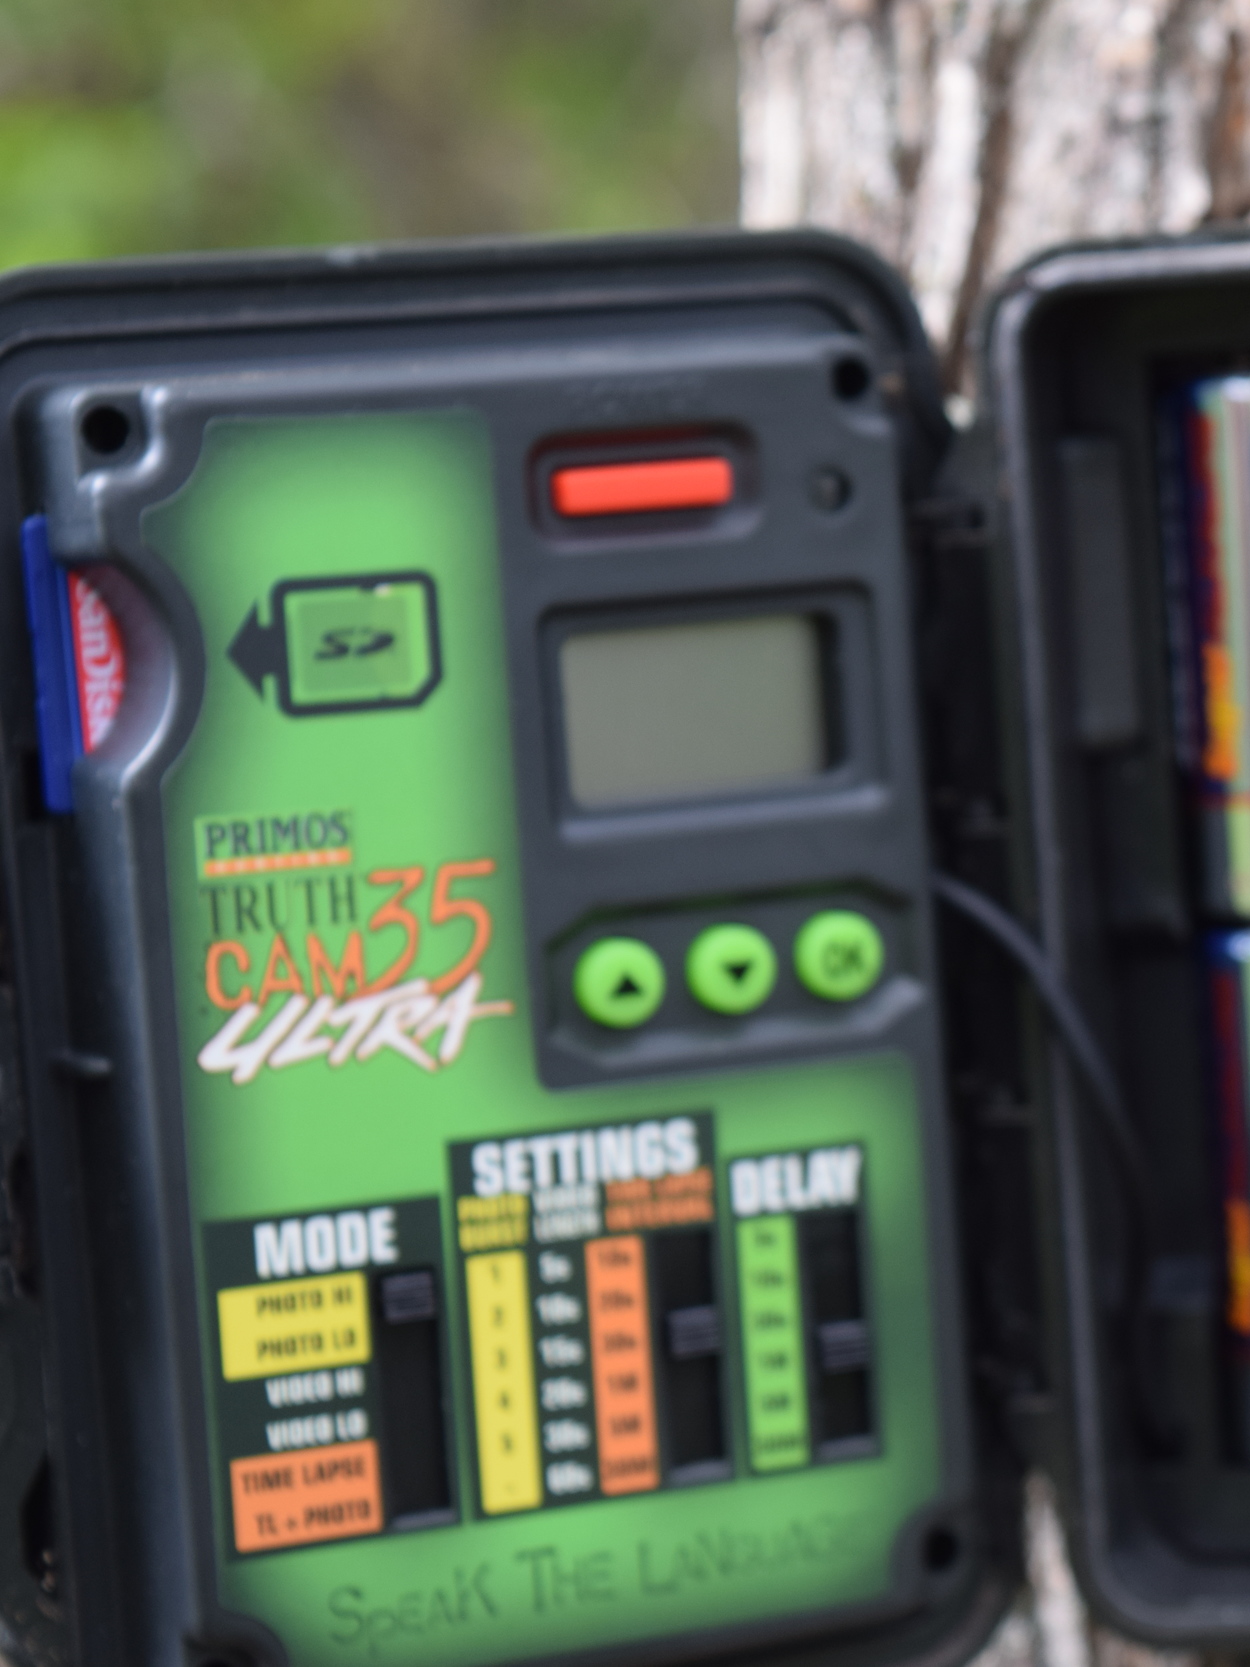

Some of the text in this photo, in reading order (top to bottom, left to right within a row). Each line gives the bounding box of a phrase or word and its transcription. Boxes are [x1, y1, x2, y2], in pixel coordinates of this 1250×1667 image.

[204, 811, 350, 858] PRIMOS
[202, 875, 357, 935] TRUTH
[205, 858, 496, 1010] CAM 35
[197, 970, 514, 1085] ULTRA
[472, 1116, 698, 1197] SETTINGS
[729, 1144, 861, 1217] DELAY
[254, 1206, 398, 1280] MODE
[256, 1288, 324, 1317] PHOTO
[257, 1329, 356, 1361] PHOTO LO
[266, 1370, 333, 1408] VIDEO
[266, 1408, 369, 1451] VIDEO LO
[241, 1455, 365, 1496] TIME LAPSE
[304, 1500, 372, 1529] PHOTO
